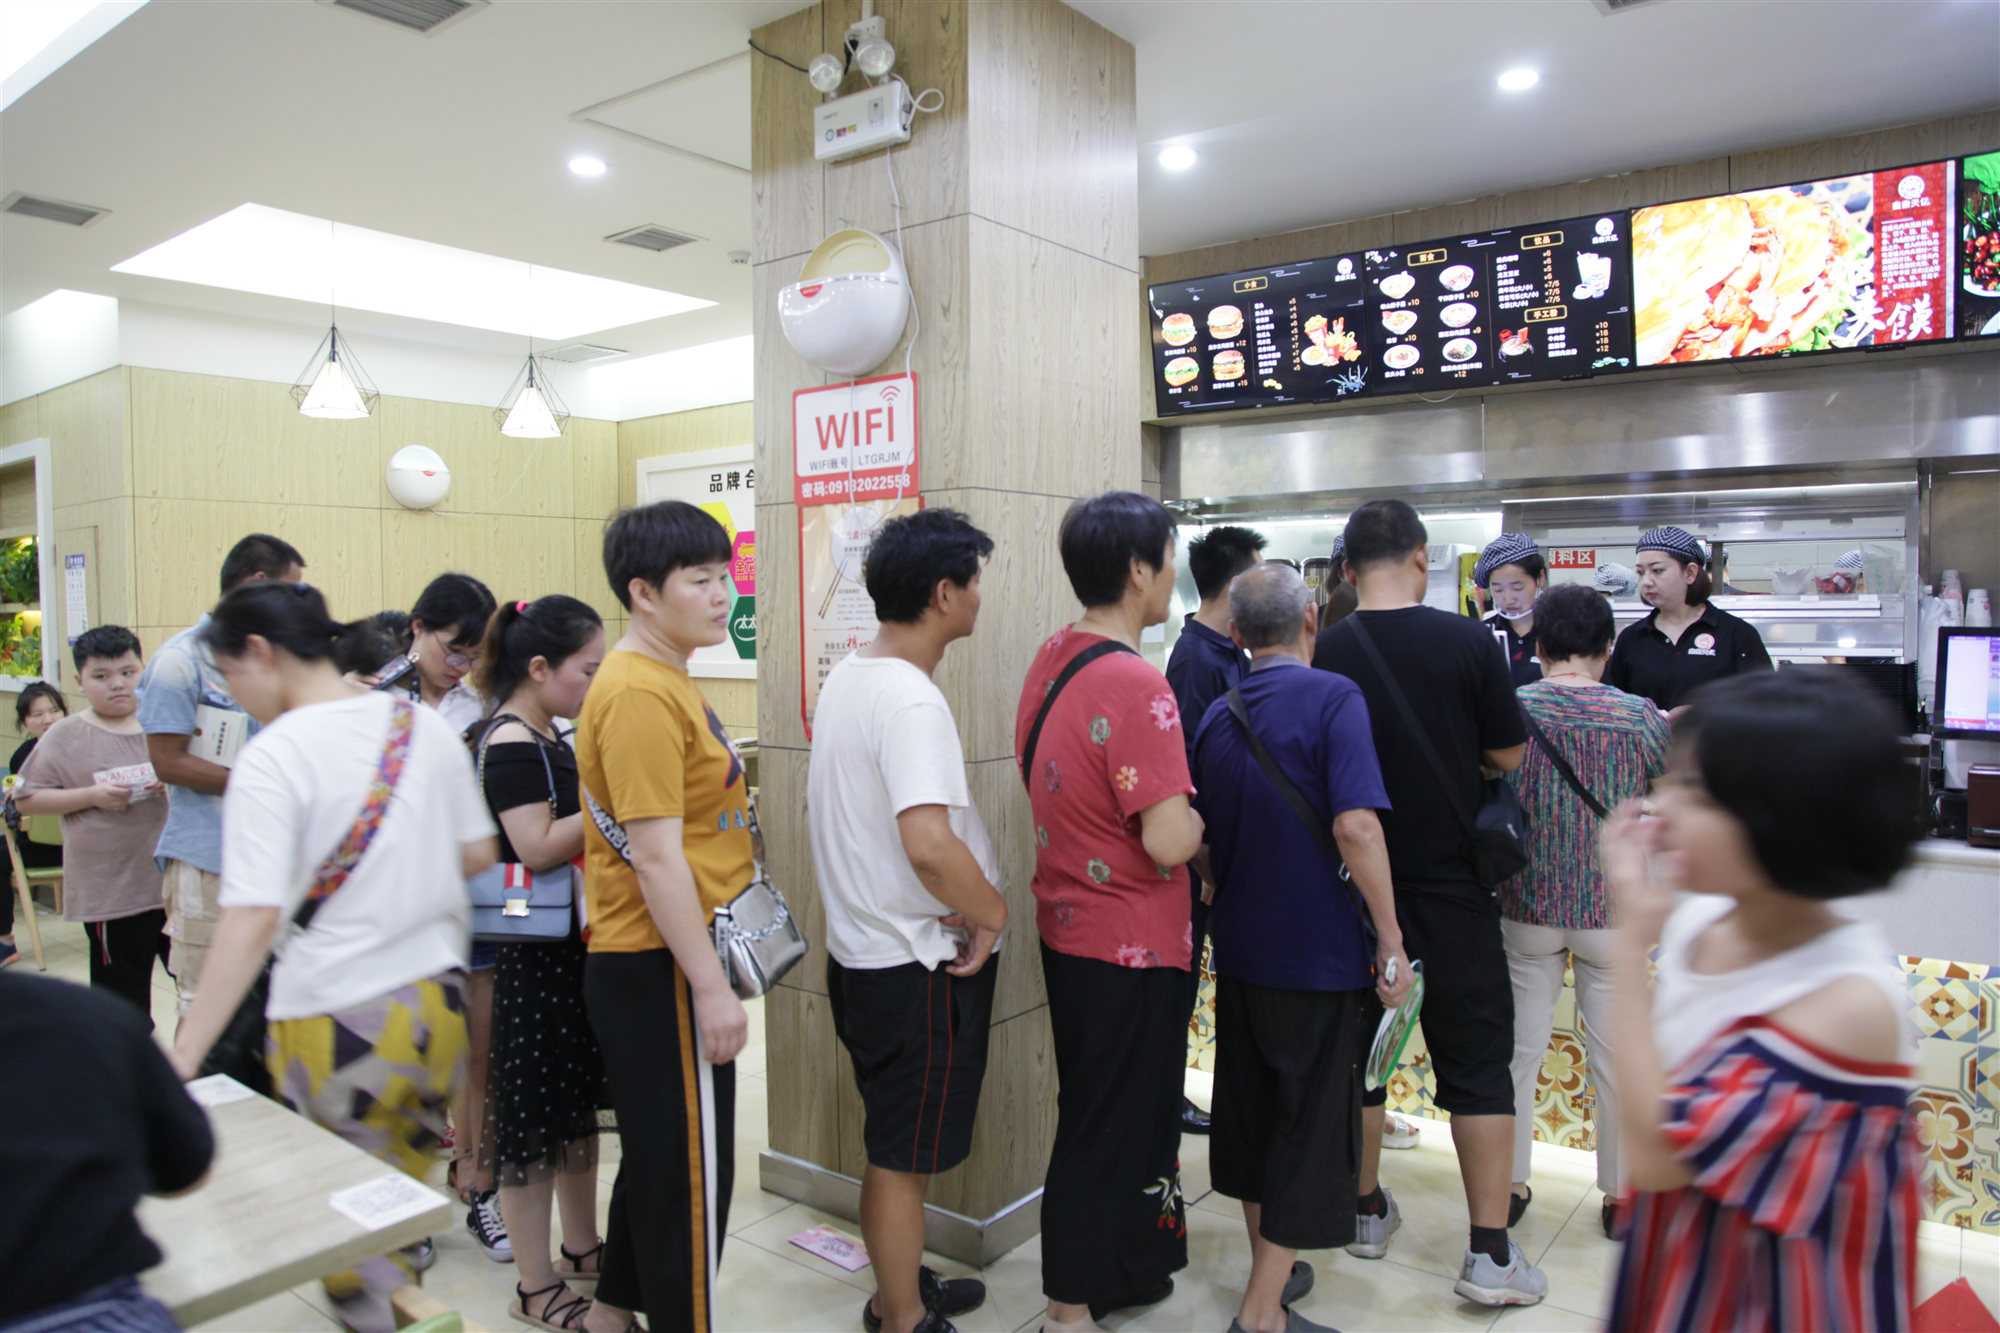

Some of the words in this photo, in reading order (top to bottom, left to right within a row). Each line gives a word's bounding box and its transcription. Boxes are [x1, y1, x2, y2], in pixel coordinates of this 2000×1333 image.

[1533, 235, 1551, 246] 饮品
[1243, 280, 1258, 289] 小食
[1533, 308, 1559, 320] 手工粉
[815, 405, 894, 451] WIFI
[809, 456, 848, 471] WIFI账号
[858, 451, 901, 466] LTGRJM
